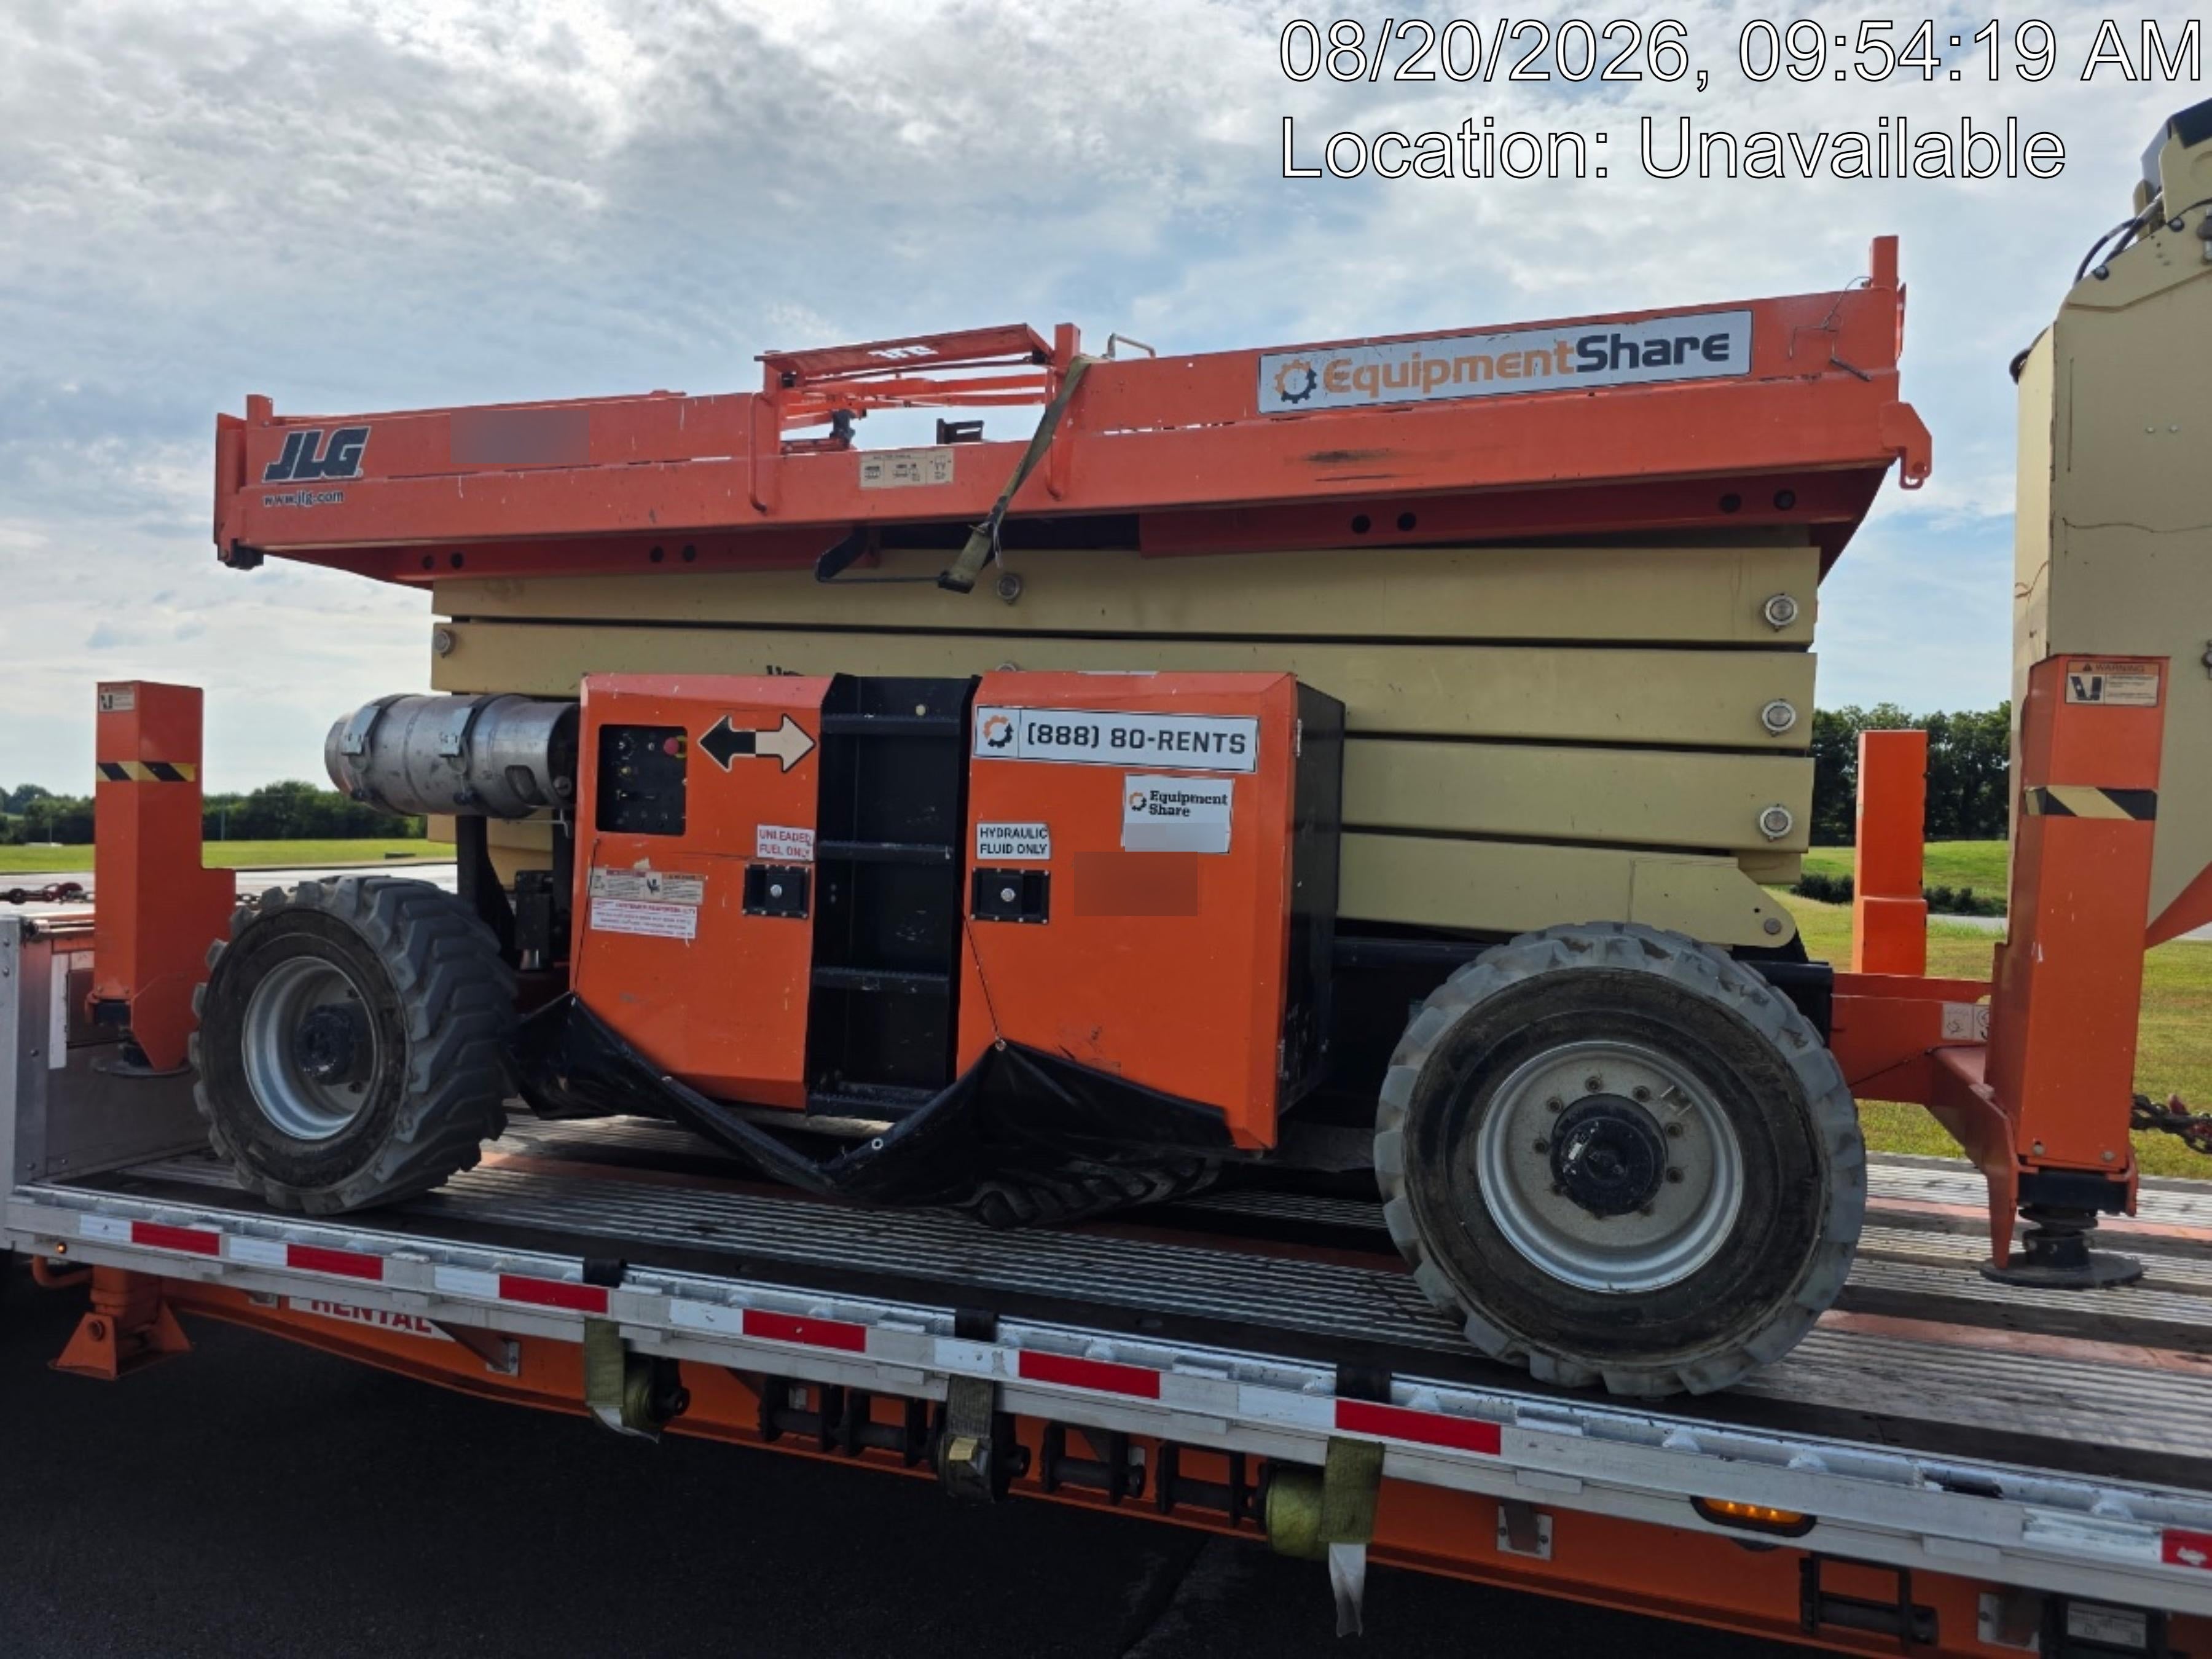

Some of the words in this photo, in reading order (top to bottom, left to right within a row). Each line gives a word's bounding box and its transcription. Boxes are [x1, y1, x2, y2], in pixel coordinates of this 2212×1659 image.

[1324, 333, 1730, 398] EquipmentShare
[262, 426, 372, 483] JLG
[264, 490, 345, 508] www.jlg.com
[1027, 722, 1100, 748] (888)
[1110, 729, 1246, 755] 80-RENTS
[1149, 790, 1228, 806] Equipment
[1148, 804, 1191, 817] Share
[979, 827, 1048, 839] HYDRAULIC
[759, 844, 783, 856] FUEL
[979, 844, 1014, 855] FLUID
[1017, 844, 1048, 855] ONLY
